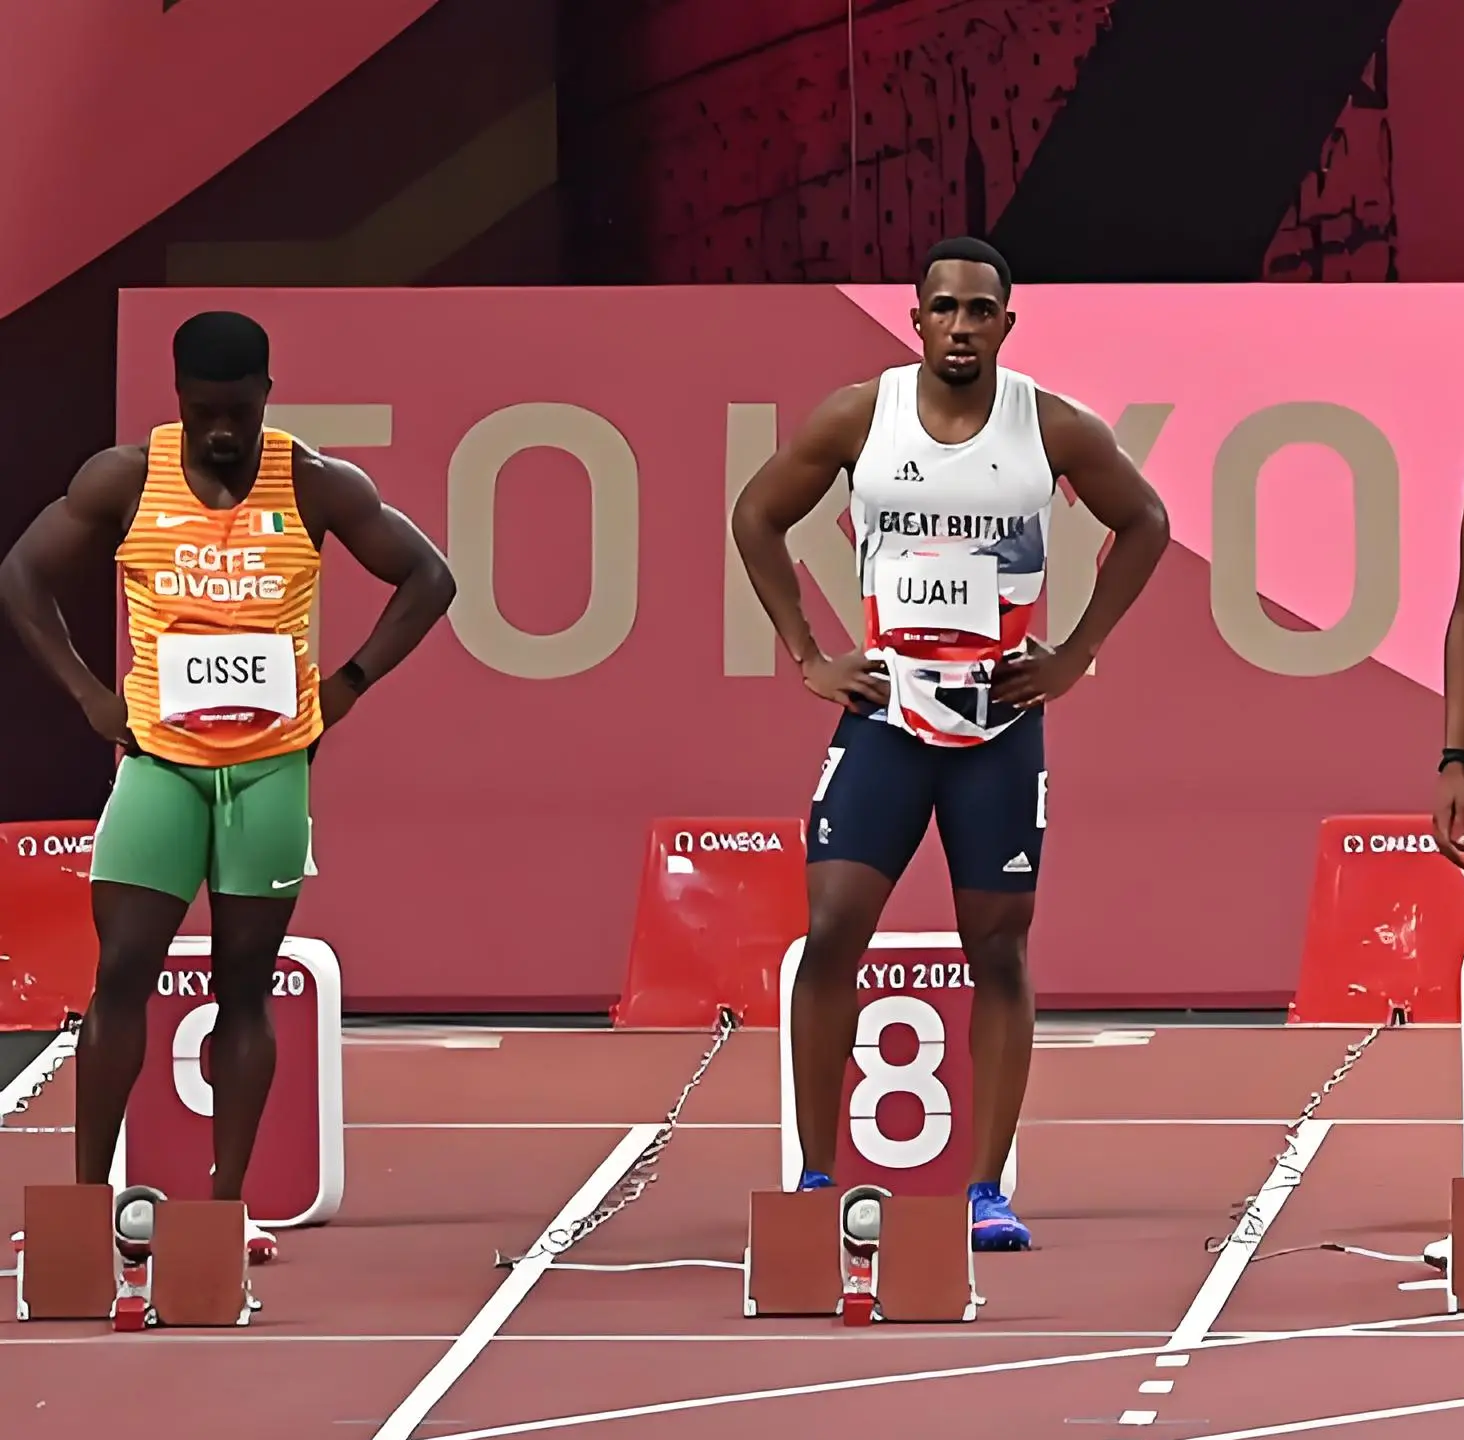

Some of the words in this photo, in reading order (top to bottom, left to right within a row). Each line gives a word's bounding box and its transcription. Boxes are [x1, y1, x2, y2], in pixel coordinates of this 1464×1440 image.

[897, 577, 968, 605] UJAH
[186, 656, 267, 684] CISSE
[157, 970, 213, 997] OKY
[271, 970, 305, 997] 20
[856, 963, 906, 990] KYO
[849, 996, 952, 1169] 8
